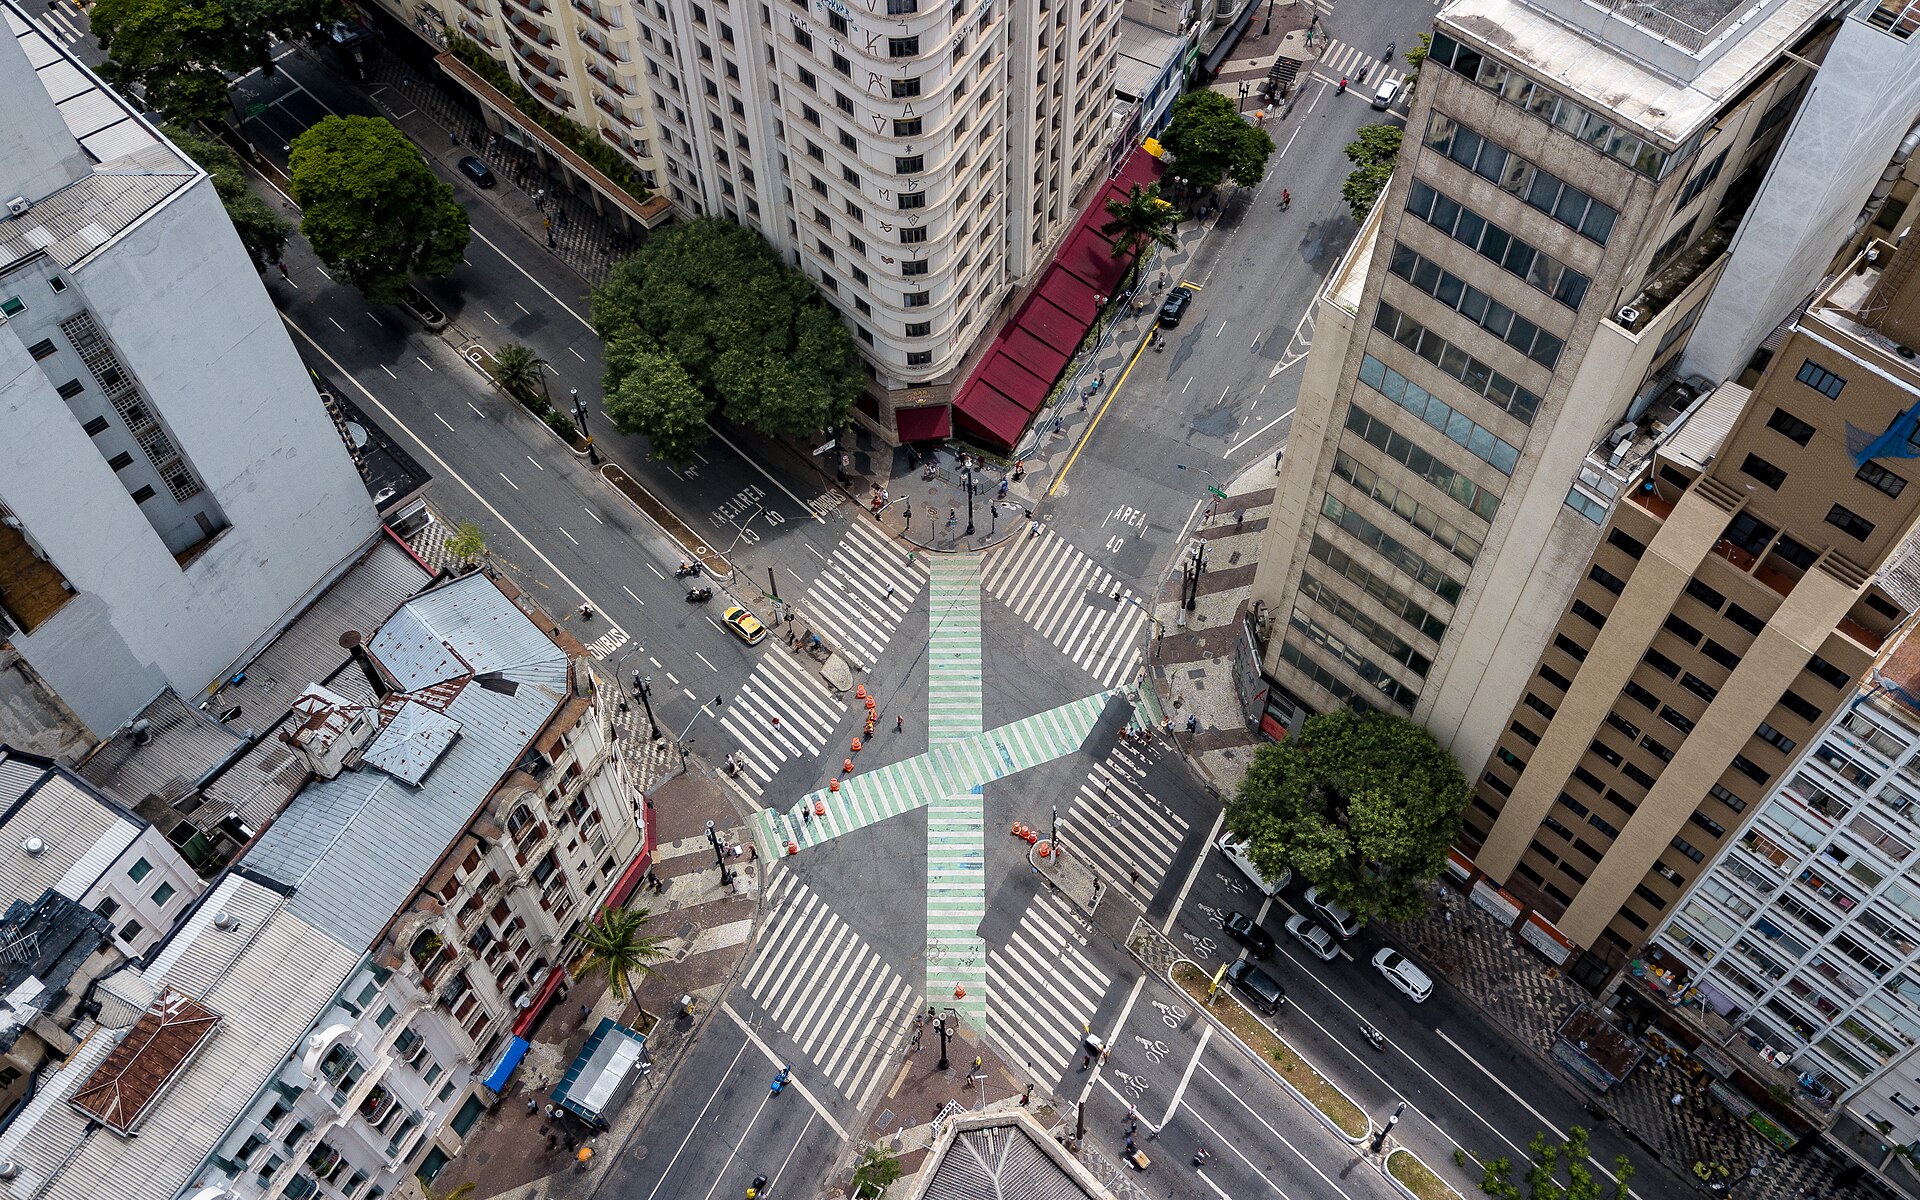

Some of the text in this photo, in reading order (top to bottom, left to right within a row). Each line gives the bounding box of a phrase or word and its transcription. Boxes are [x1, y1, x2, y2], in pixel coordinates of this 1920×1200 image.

[732, 484, 766, 516] AREA
[1113, 504, 1147, 528] AREA
[1105, 535, 1124, 553] 40
